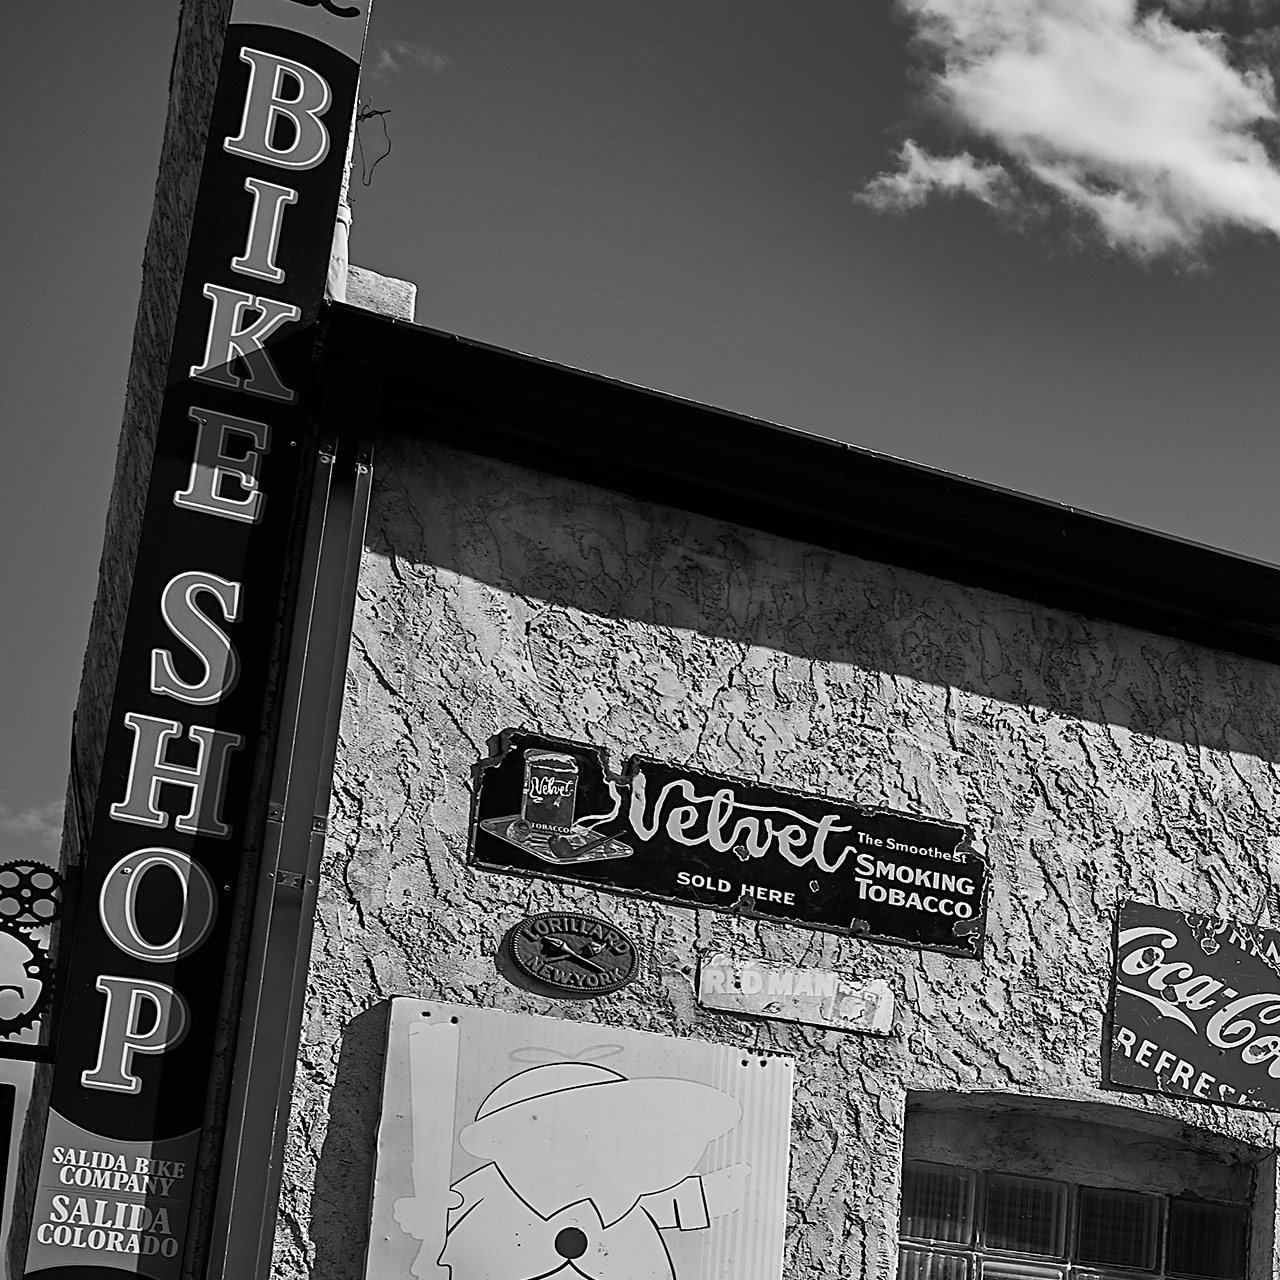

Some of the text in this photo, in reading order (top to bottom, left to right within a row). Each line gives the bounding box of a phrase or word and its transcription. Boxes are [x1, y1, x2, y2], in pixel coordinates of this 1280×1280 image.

[173, 46, 333, 524] BIKE
[529, 776, 574, 799] Velvet
[81, 570, 245, 1095] SHOP
[629, 771, 857, 873] Velvet
[857, 830, 968, 865] The Smoothest
[677, 871, 796, 906] SOLD HERE
[854, 855, 976, 897] SMOKING
[854, 877, 974, 920] TOBACCO
[521, 918, 630, 953] LORILLARD
[768, 970, 836, 998] MAN
[52, 1146, 186, 1179] SALIDA BIKE
[60, 1165, 176, 1197] COMPANY
[49, 1194, 173, 1236] SALIDA
[37, 1223, 179, 1258] COLORADO
